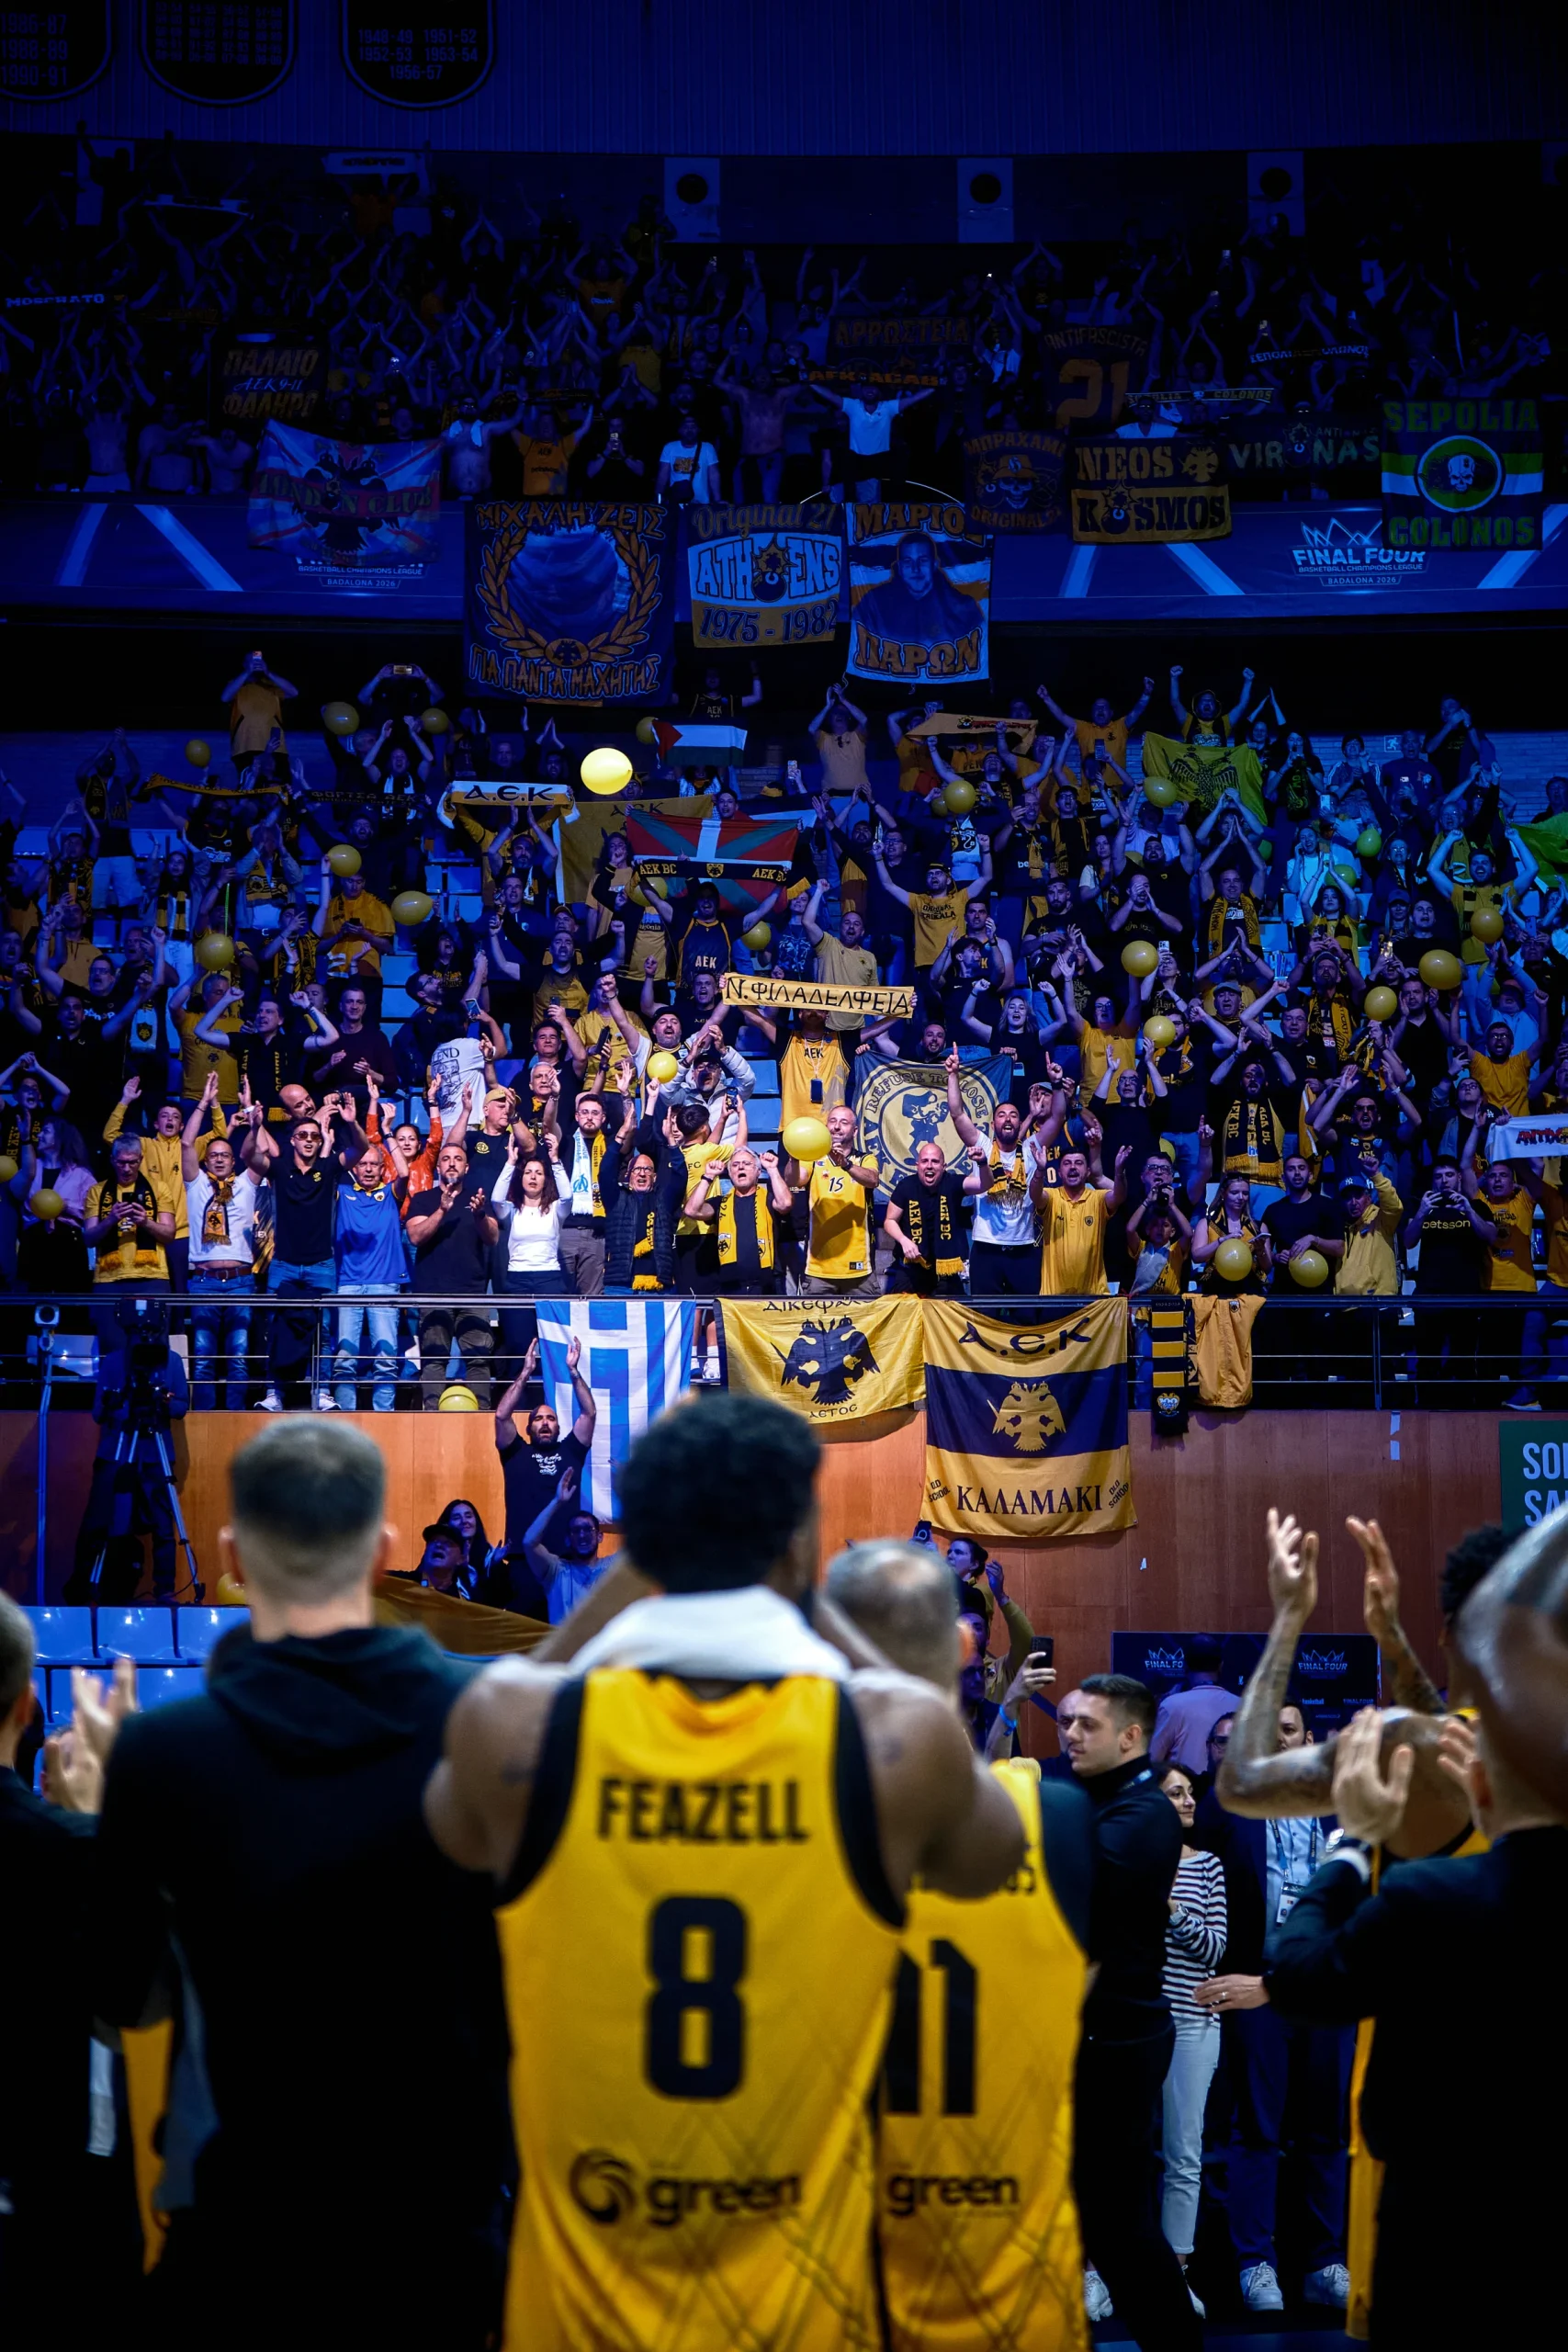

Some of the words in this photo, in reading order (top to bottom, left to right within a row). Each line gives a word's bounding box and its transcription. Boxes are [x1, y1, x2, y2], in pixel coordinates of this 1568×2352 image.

[1382, 400, 1539, 432] SEPOLIA
[1074, 446, 1174, 481] NEOS
[693, 503, 803, 537] Original
[1388, 515, 1536, 548] COLONOS
[298, 566, 345, 574] BASKETBALL
[393, 567, 423, 575] LEAGUE
[1292, 549, 1364, 566] FINAL
[1298, 564, 1346, 573] BASKETBALL
[1348, 563, 1392, 572] CHAMPIONS
[1393, 563, 1424, 571] LEAGUE
[1327, 577, 1373, 586] BADALONA
[1377, 576, 1397, 585] 2026
[700, 606, 761, 642] 1975
[781, 601, 838, 642] 1982
[855, 627, 982, 679] ΠΑΡΩΝ
[662, 864, 677, 875] BC
[694, 956, 717, 969] AEK
[866, 1072, 925, 1114] REFUSE
[960, 1080, 989, 1119] LOSE
[829, 1176, 844, 1193] 15
[908, 1199, 922, 1227] AEK
[1422, 1219, 1471, 1230] betsson
[956, 1485, 1102, 1515] ΚΑΛΑΜΑΚΙ
[1298, 1662, 1324, 1671] FINAL
[599, 1779, 810, 1839] FEAZELL
[648, 1896, 746, 2102] 8
[648, 2173, 802, 2226] green
[886, 2173, 1019, 2215] green
